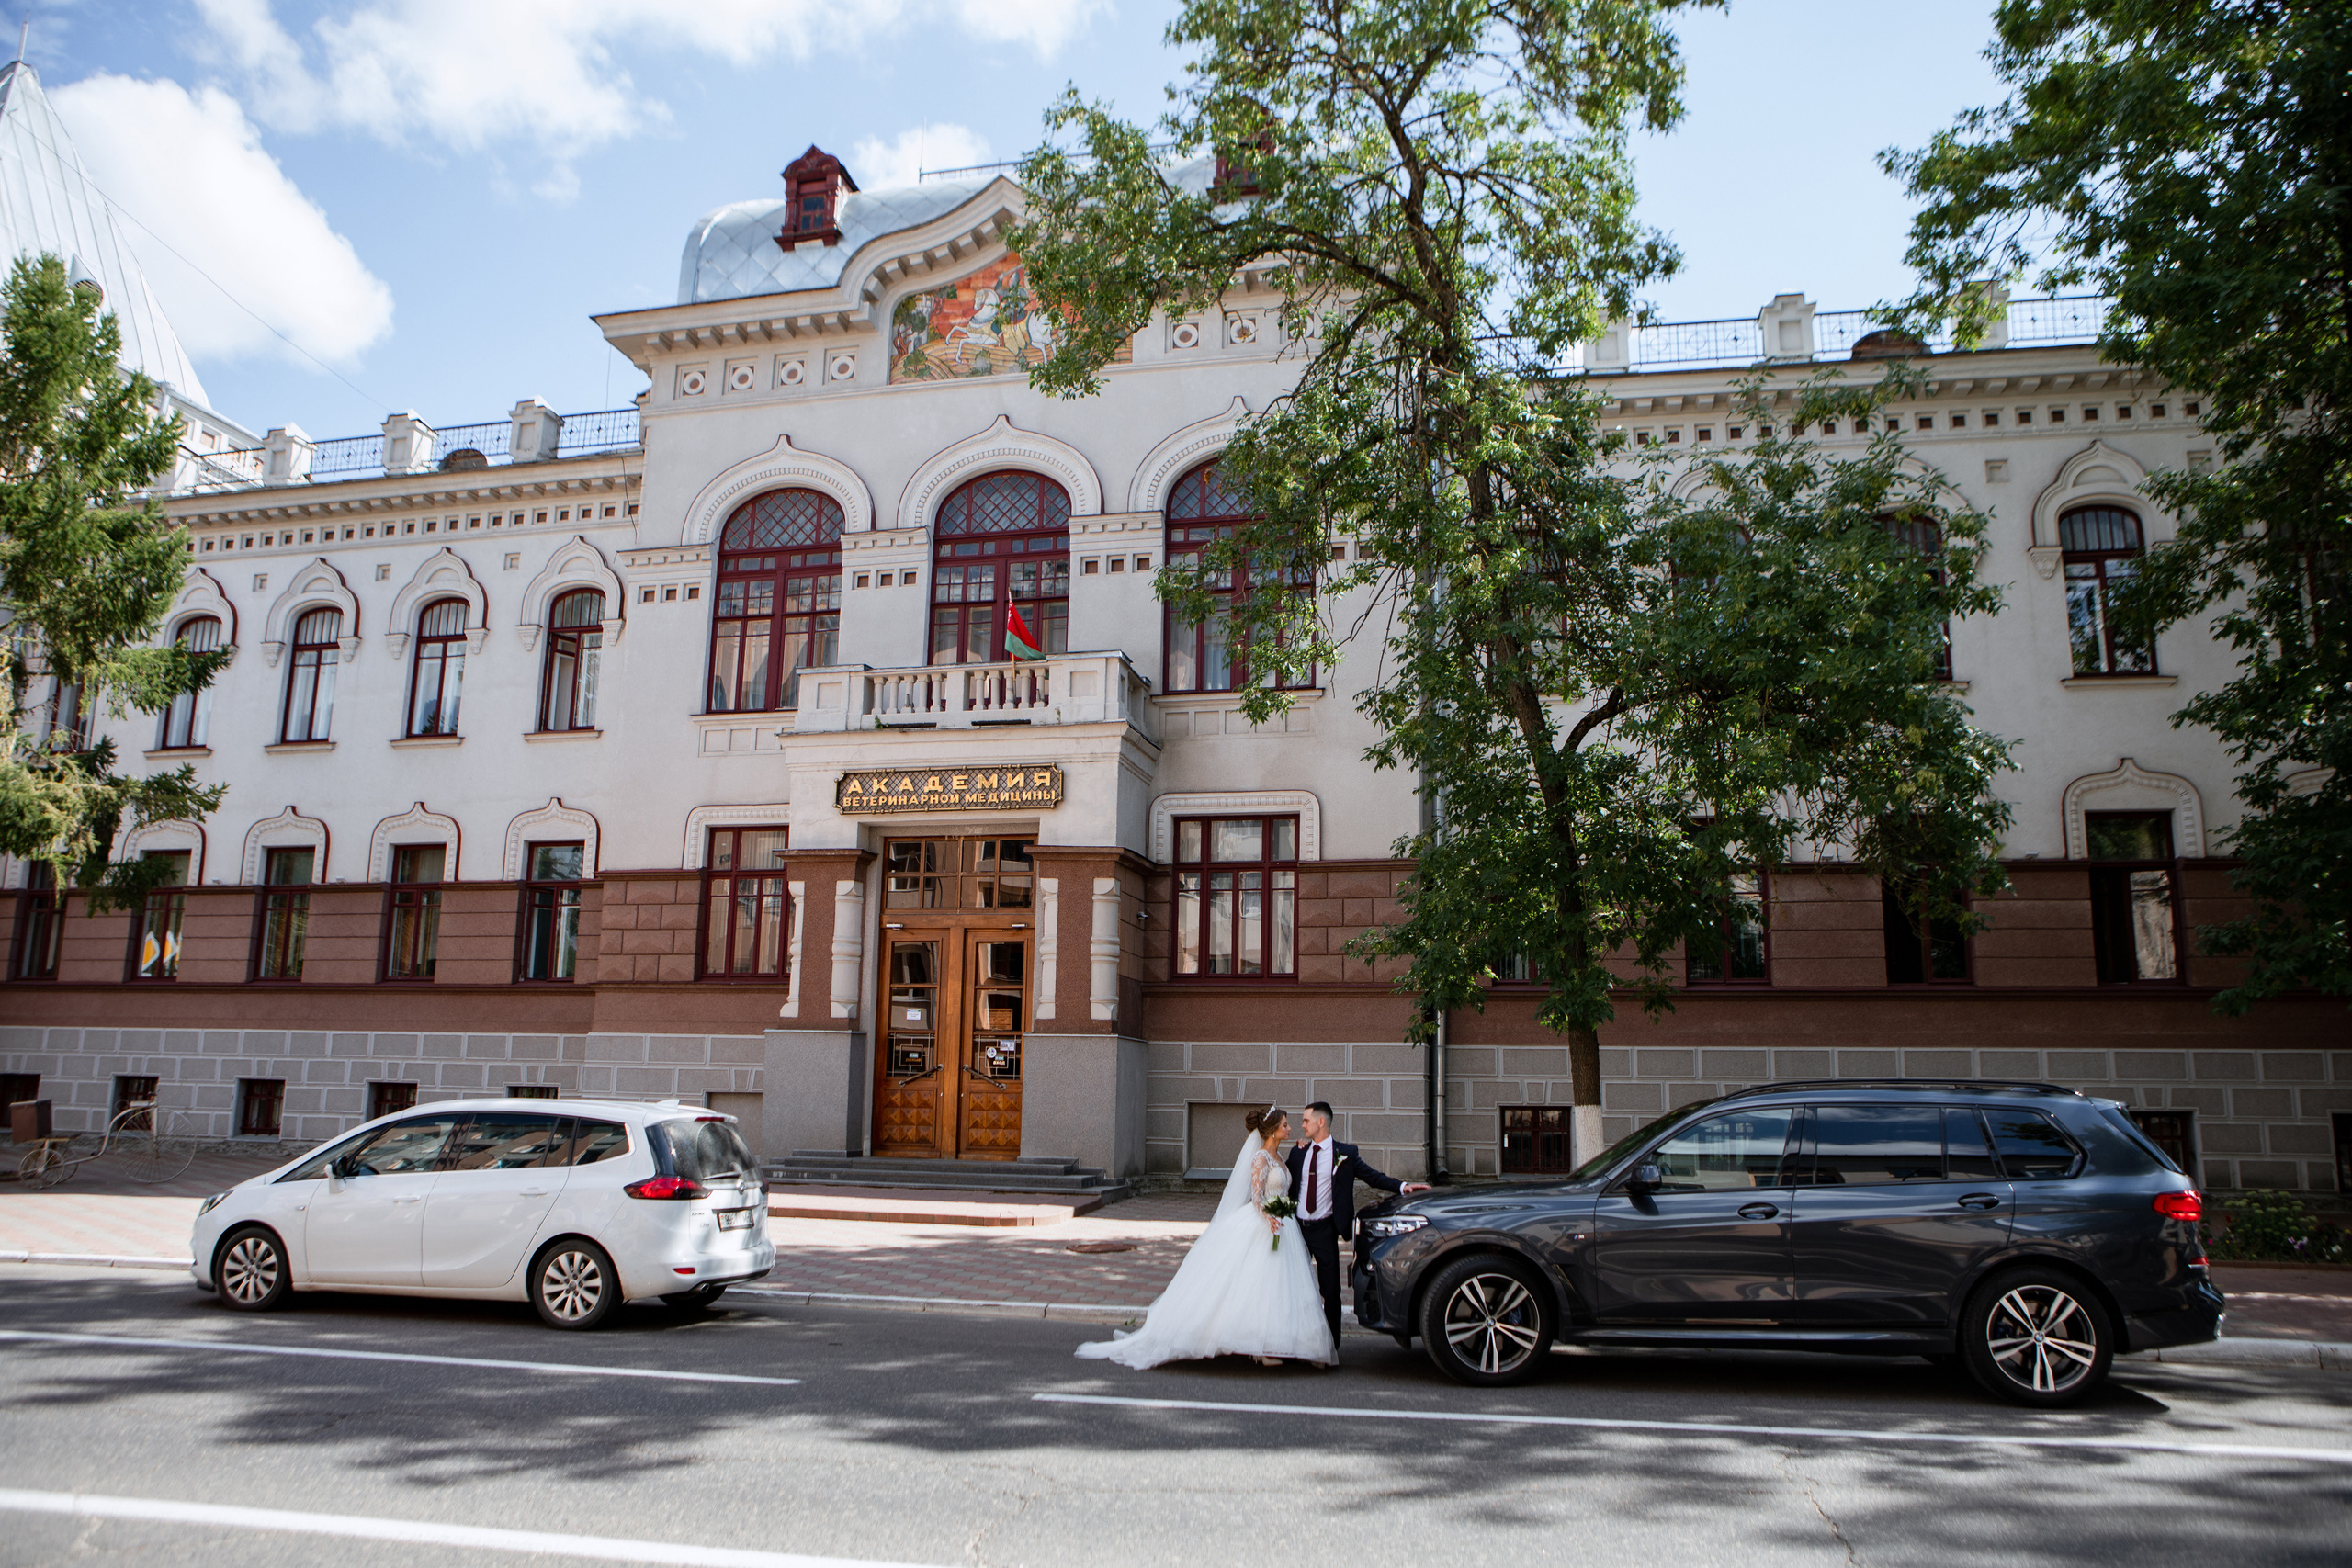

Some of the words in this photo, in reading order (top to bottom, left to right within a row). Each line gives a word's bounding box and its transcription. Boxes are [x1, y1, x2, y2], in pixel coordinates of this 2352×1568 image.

[847, 772, 1051, 794] АКАДЕМИЯ
[842, 792, 959, 807] ВЕТЕРИНАРНОЙ
[965, 790, 1056, 804] МЕДИЦИНЫ
